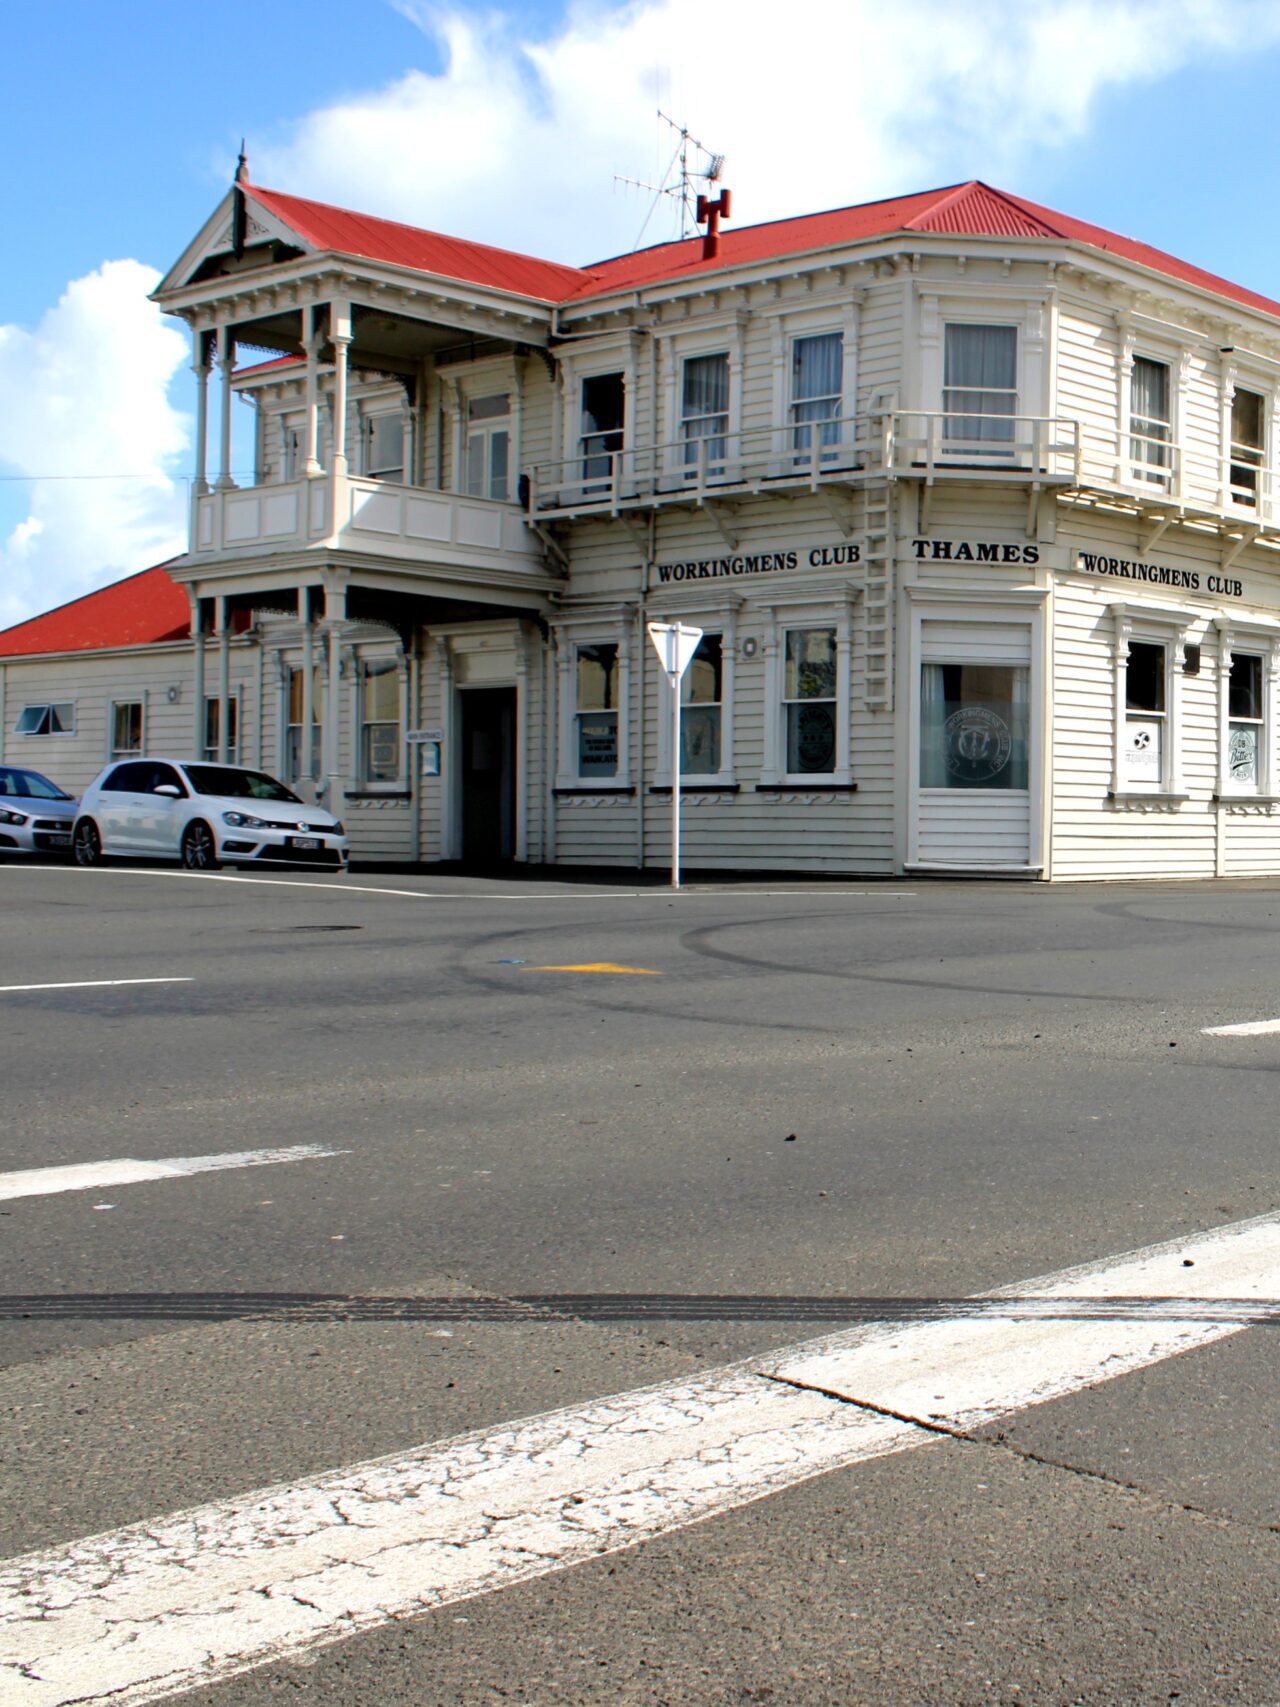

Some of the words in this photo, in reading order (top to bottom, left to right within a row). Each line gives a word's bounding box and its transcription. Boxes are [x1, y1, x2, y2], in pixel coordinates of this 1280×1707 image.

[658, 551, 798, 583] WORKINGMENS
[808, 544, 860, 567] CLUB
[911, 539, 1040, 564] THAMES
[1081, 552, 1200, 590] WORKINGMENS
[1207, 575, 1243, 597] CLUB
[1230, 748, 1253, 764] Bitter
